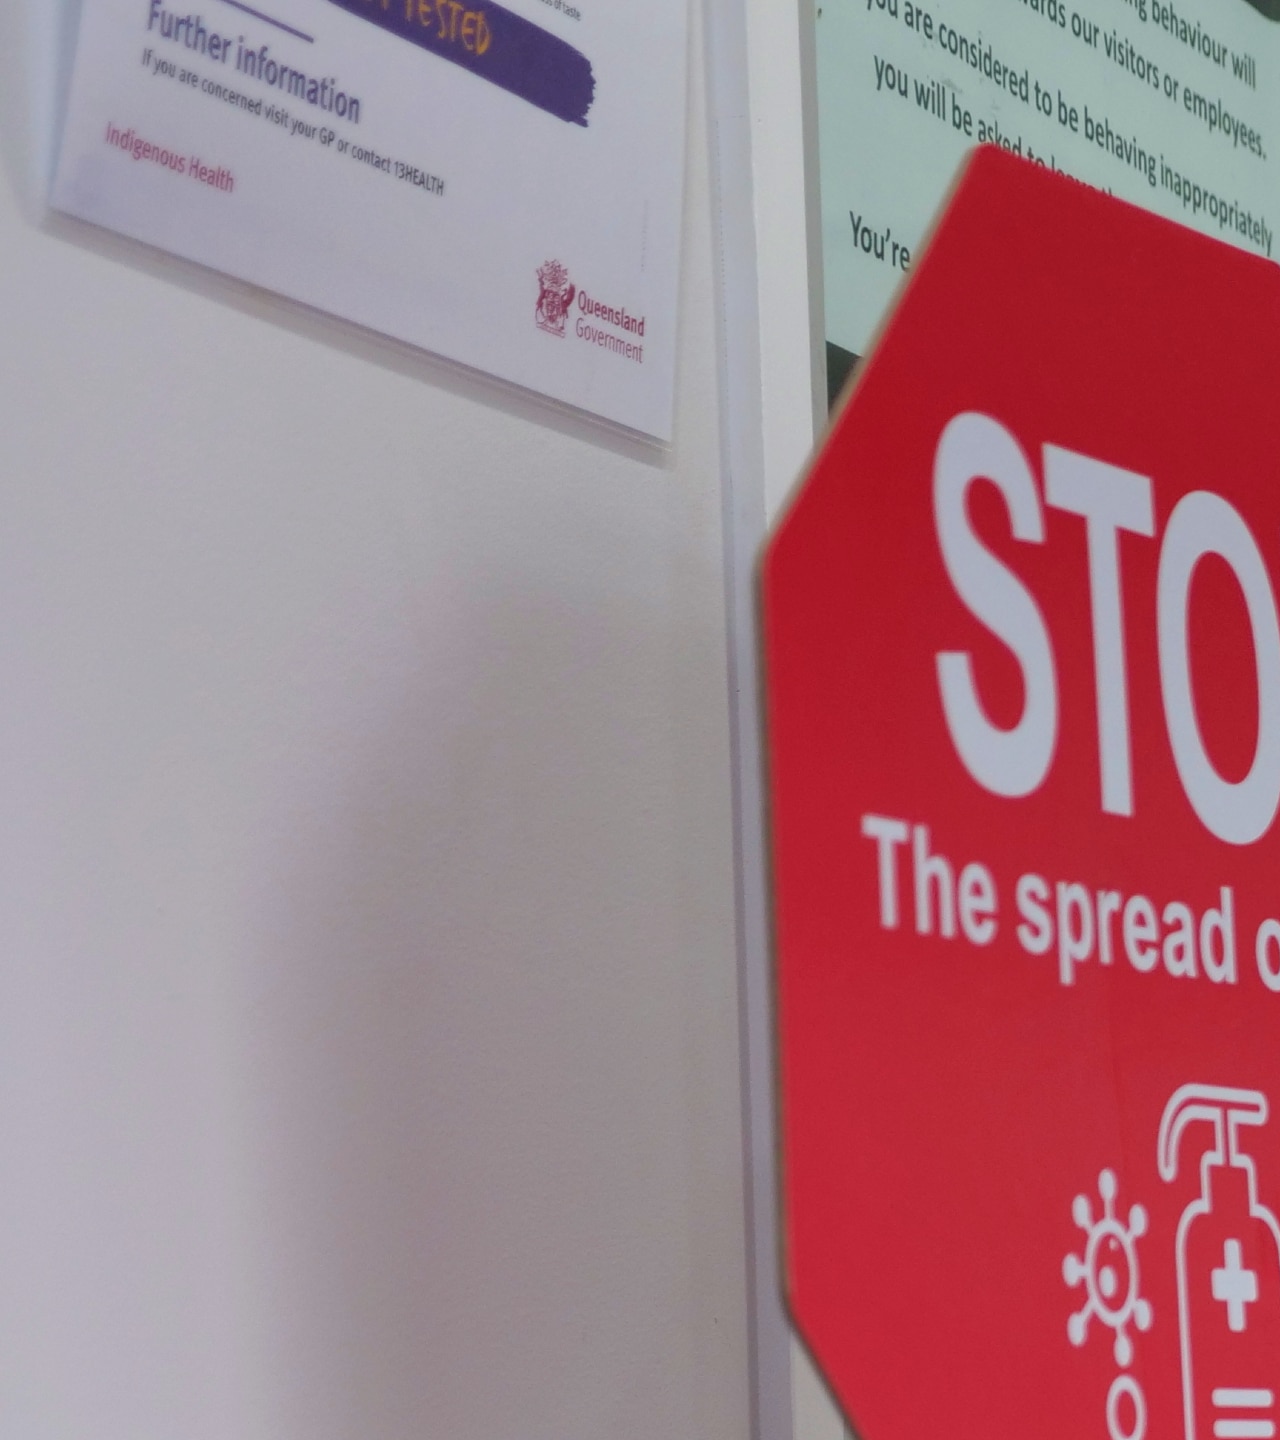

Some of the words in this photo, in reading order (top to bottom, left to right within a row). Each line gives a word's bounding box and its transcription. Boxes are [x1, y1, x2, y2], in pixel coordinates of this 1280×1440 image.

[563, 1, 581, 21] taste
[1151, 0, 1228, 68] behaviour
[1231, 50, 1257, 90] will
[147, 0, 232, 64] Further
[236, 35, 361, 124] information
[873, 54, 908, 98] you
[914, 78, 946, 121] will
[952, 93, 973, 137] be
[1071, 12, 1100, 49] our
[1104, 28, 1160, 89] visitors
[1163, 75, 1179, 102] or
[1183, 86, 1267, 160] employees.
[106, 121, 185, 173] Indigenous
[188, 158, 235, 193] Health
[142, 48, 153, 67] If
[153, 57, 177, 78] you
[179, 69, 199, 88] are
[201, 78, 263, 117] concerned
[264, 101, 288, 129] visit
[290, 116, 317, 141] your
[319, 126, 335, 147] GP
[337, 138, 349, 155] or
[351, 142, 391, 175] contact
[393, 160, 444, 197] 13HEALTH
[904, 1, 933, 39] are
[938, 22, 1029, 103] considered
[1034, 80, 1053, 117] to
[1057, 89, 1079, 133] be
[1083, 105, 1157, 188] behaving
[1159, 154, 1273, 257] inappropriately
[575, 317, 644, 364] Government
[577, 290, 645, 337] Queensland
[861, 813, 998, 946] The
[1015, 873, 1239, 986] spread
